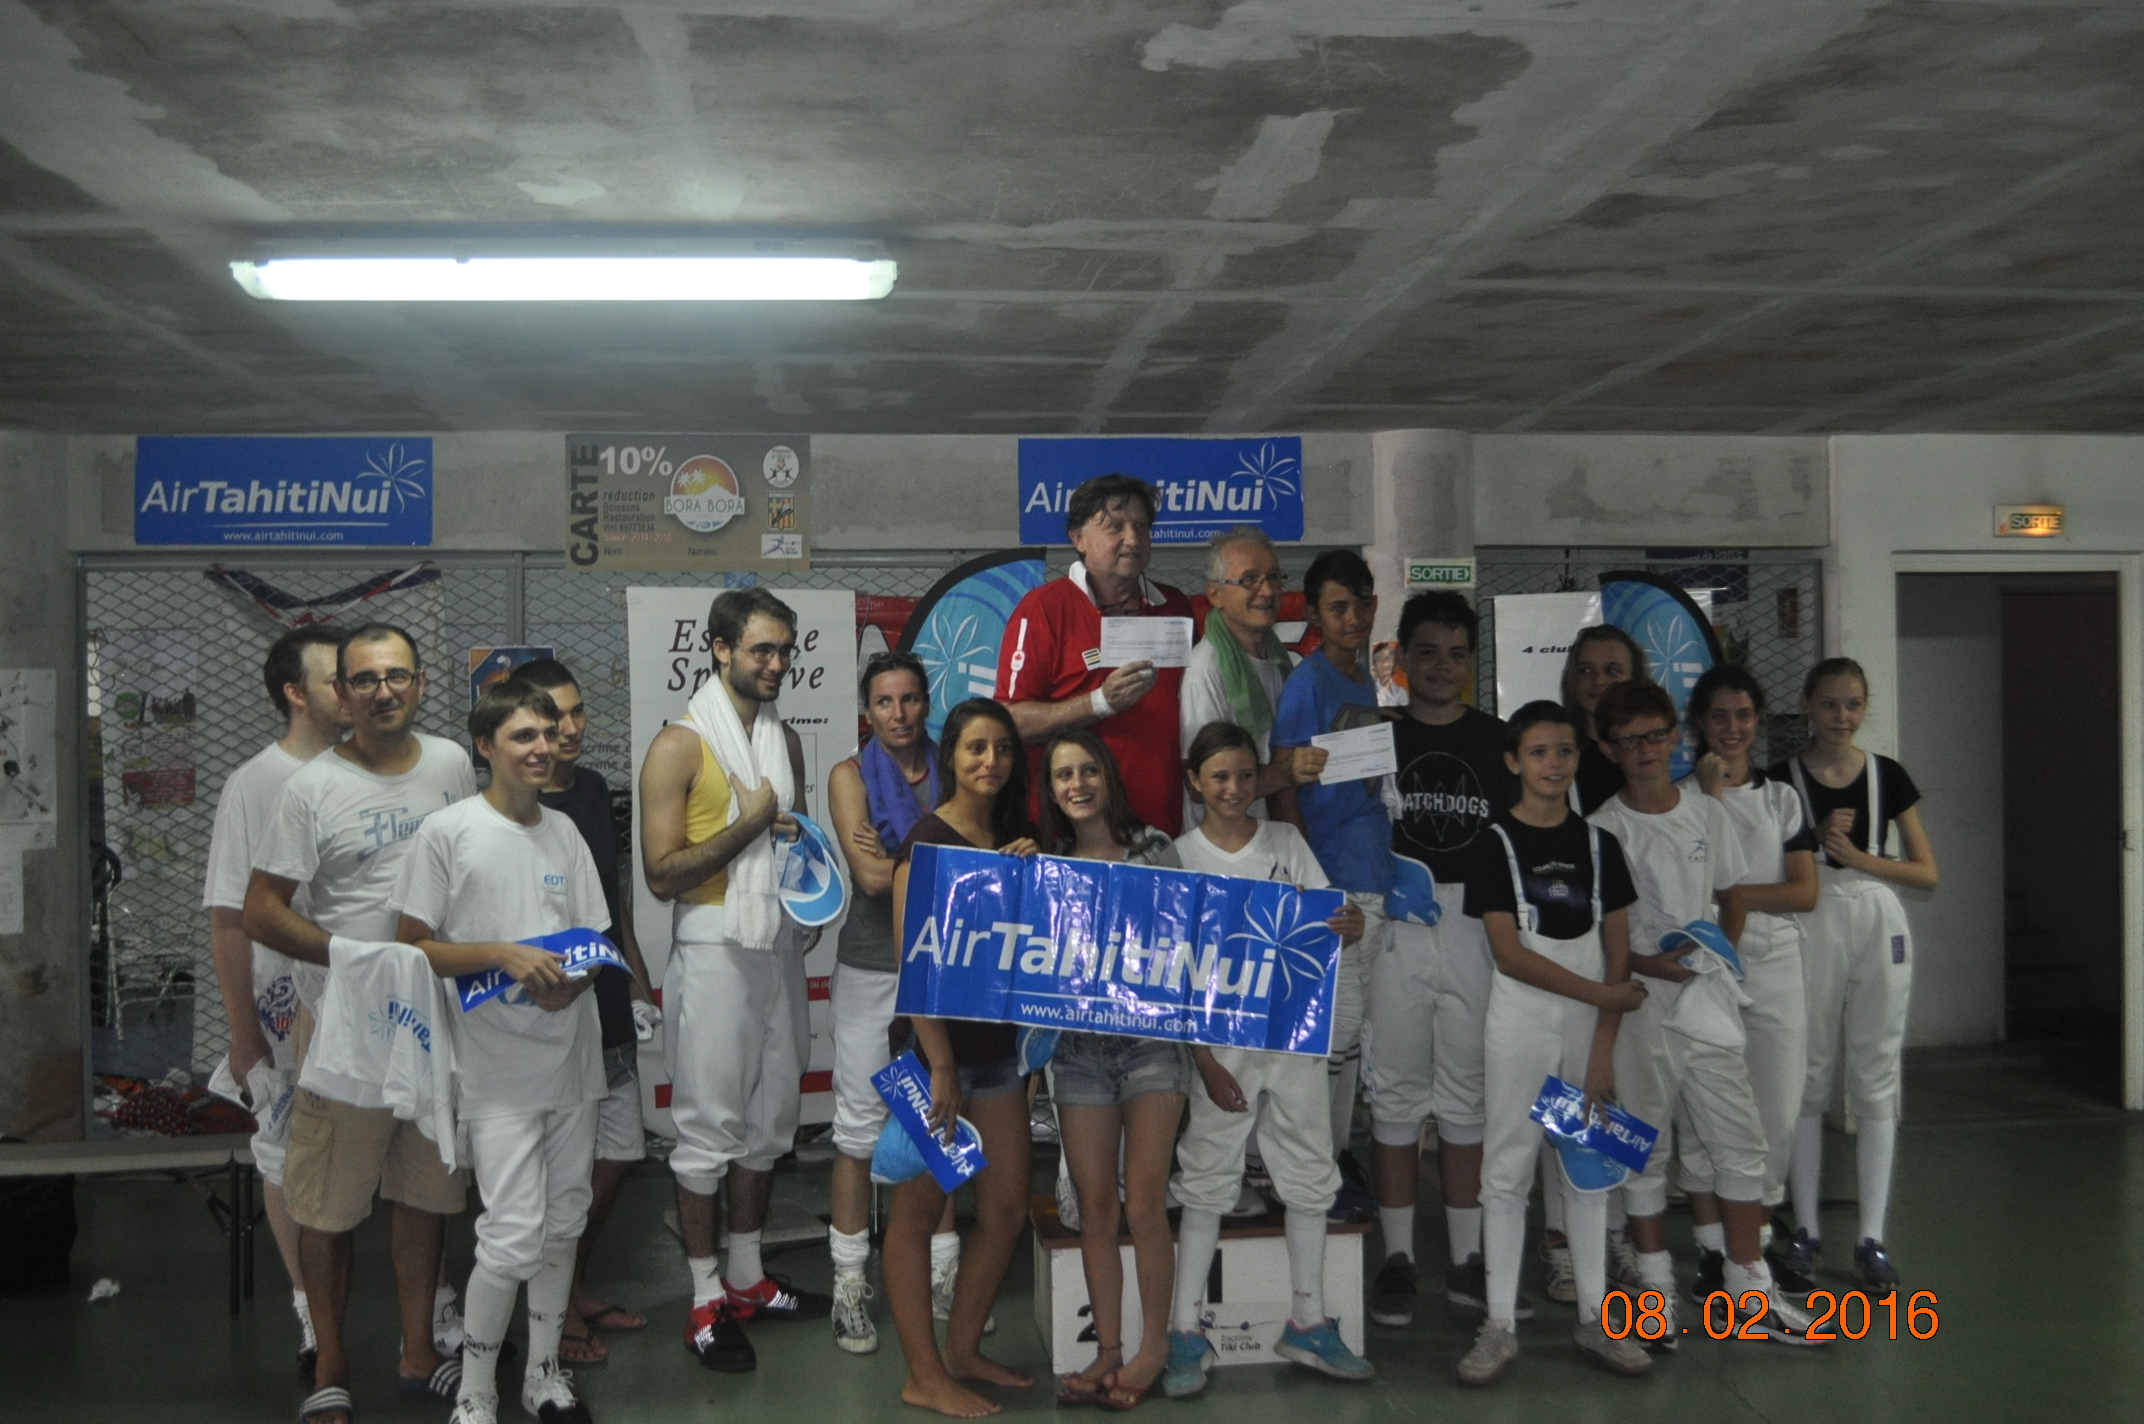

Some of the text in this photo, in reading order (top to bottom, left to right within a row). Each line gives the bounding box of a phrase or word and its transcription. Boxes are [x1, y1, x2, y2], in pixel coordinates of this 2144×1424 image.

[600, 446, 673, 476] 10%
[141, 480, 392, 514] AirTahitiNui
[603, 489, 655, 501] réduction
[570, 445, 599, 566] CARTE
[665, 500, 743, 513] BORA BORA
[2012, 515, 2061, 528] SORTIE
[223, 530, 344, 541] www.airtahitinui.com
[1411, 567, 1464, 580] SORTIE
[1521, 645, 1534, 654] 4
[543, 874, 565, 886] EDT
[906, 915, 1276, 999] AirTahitiNui
[1020, 1000, 1197, 1033] www.airtahitinui.com
